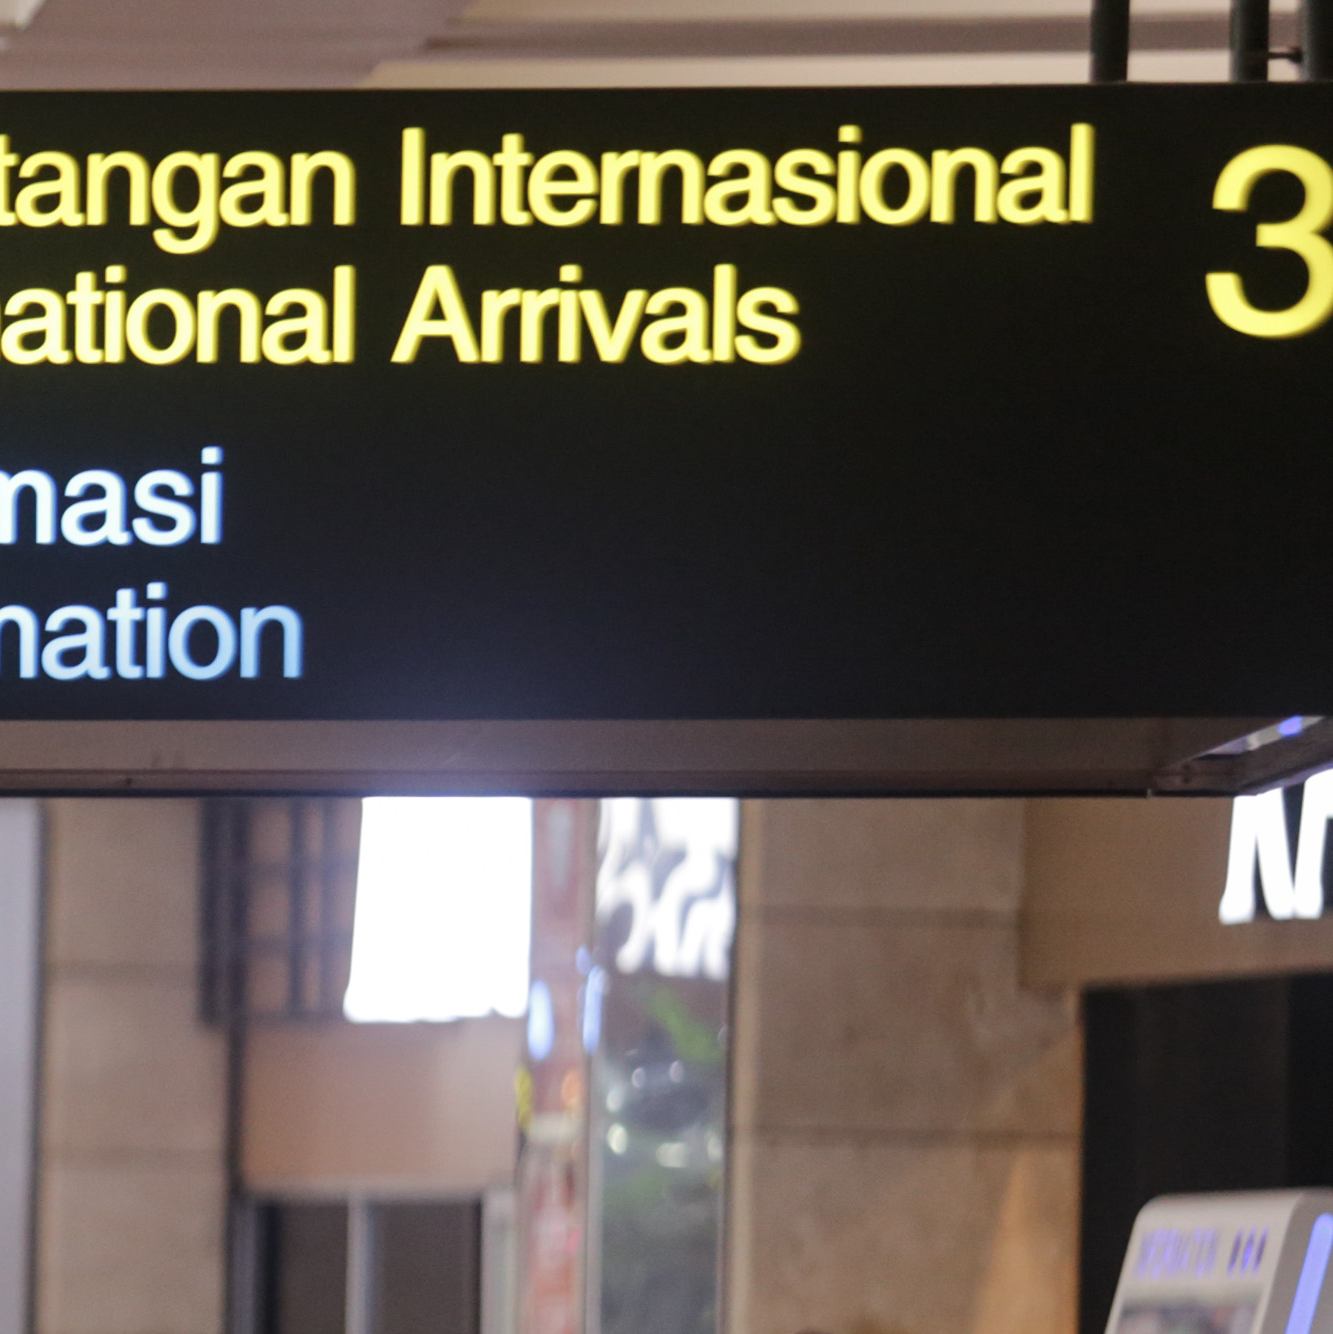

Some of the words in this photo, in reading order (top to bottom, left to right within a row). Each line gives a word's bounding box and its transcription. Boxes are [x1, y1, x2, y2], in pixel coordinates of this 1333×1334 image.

[400, 122, 1094, 227] Internasional
[1205, 144, 1333, 338] 3
[390, 263, 801, 365] Arrivals
